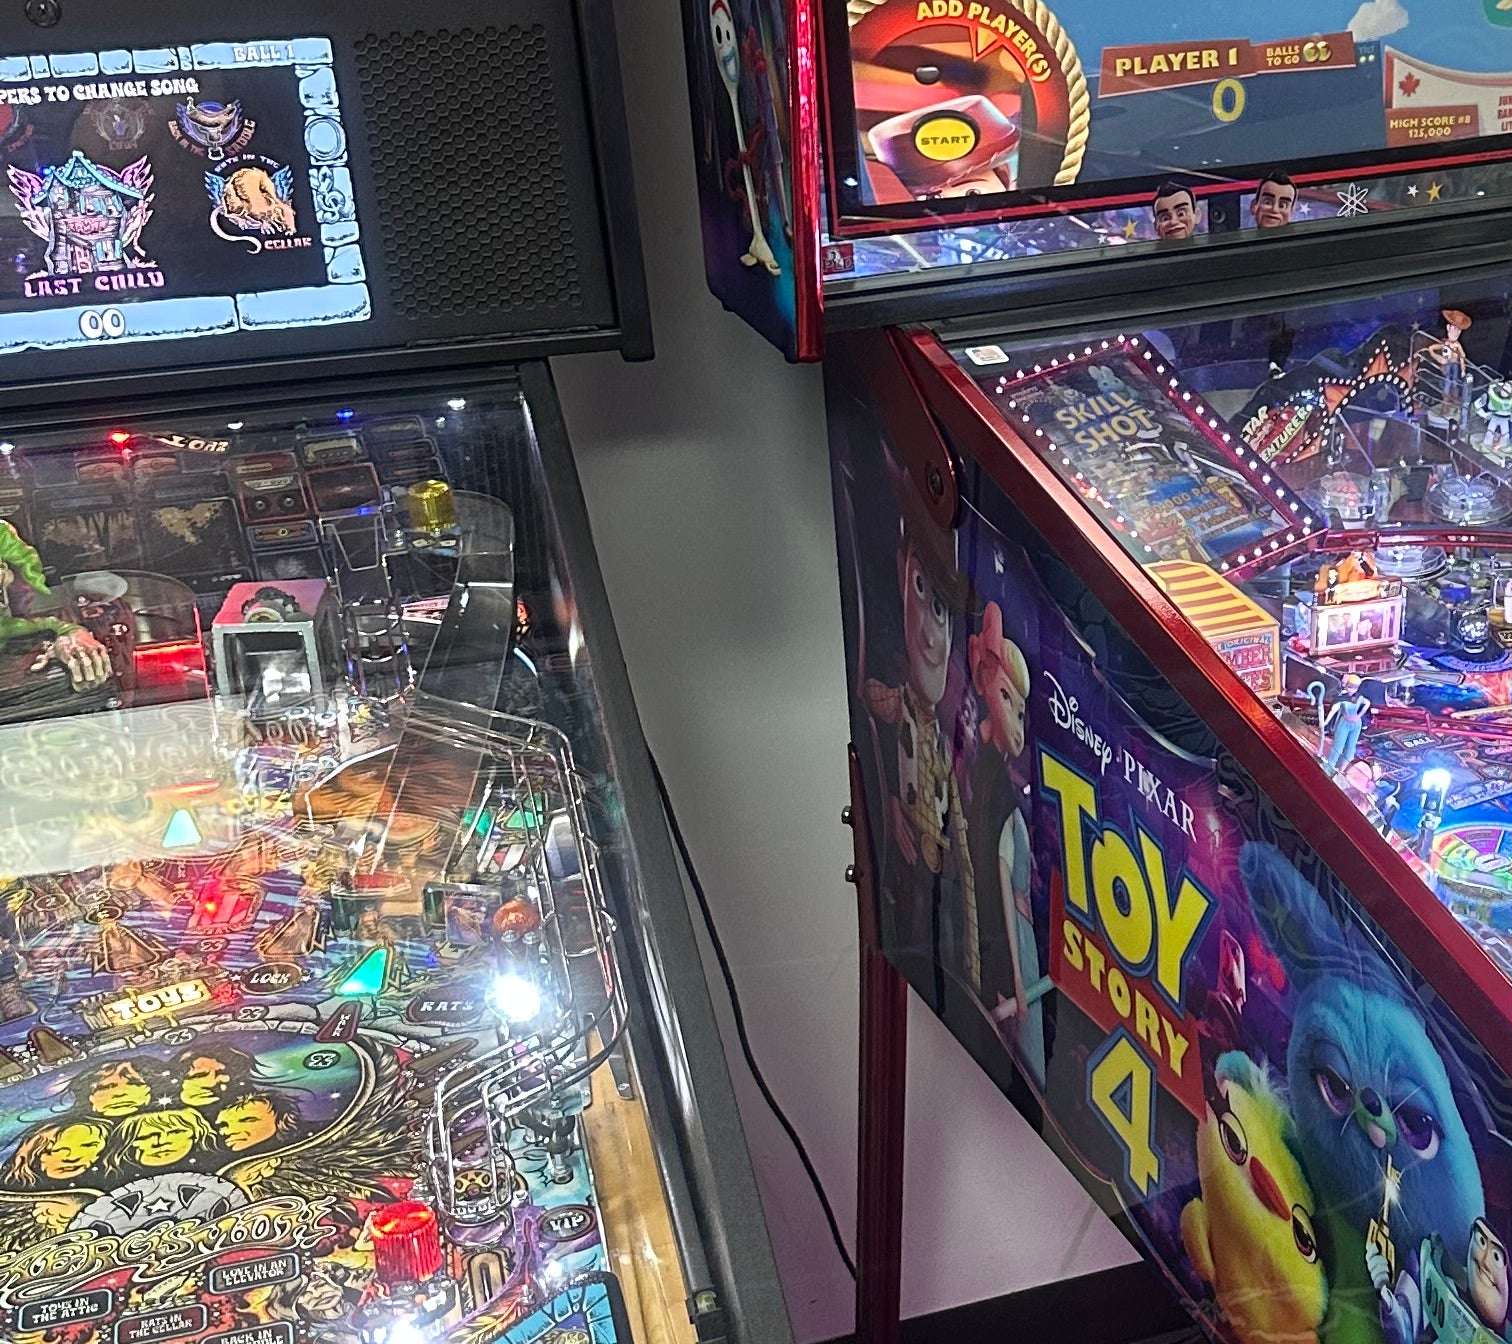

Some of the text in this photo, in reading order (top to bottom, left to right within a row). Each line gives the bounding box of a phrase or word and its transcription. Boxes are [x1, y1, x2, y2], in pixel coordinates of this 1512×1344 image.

[233, 44, 295, 62] BALL 1
[966, 2, 1051, 83] PLAYER(S)
[1266, 44, 1300, 58] BALLS
[1115, 47, 1239, 78] PLAYER 1
[1266, 55, 1300, 67] TO GO
[44, 77, 200, 103] TO CHANGE SONG
[1211, 77, 1247, 124] 0
[1389, 117, 1419, 129] HIGH
[1420, 115, 1456, 128] SCORE
[920, 134, 971, 146] START
[24, 277, 82, 298] LAST
[79, 308, 126, 339] 00
[1056, 391, 1139, 431] SKILL
[1074, 407, 1156, 453] SHOT
[1122, 754, 1198, 844] PIXAR
[1038, 751, 1217, 1016] TOY
[114, 983, 205, 1021] TOYS
[419, 1000, 474, 1013] RATS
[1062, 918, 1190, 1080] STORY
[1089, 1032, 1161, 1201] 4
[549, 1214, 585, 1234] VIP
[252, 1263, 269, 1276] IN
[269, 1258, 288, 1273] AN
[32, 1303, 99, 1325] THE ATTIC
[40, 1296, 90, 1314] TOYS IN
[141, 1313, 183, 1330] RATS IN
[149, 1318, 194, 1336] CELLAR
[256, 1328, 273, 1340] IN
